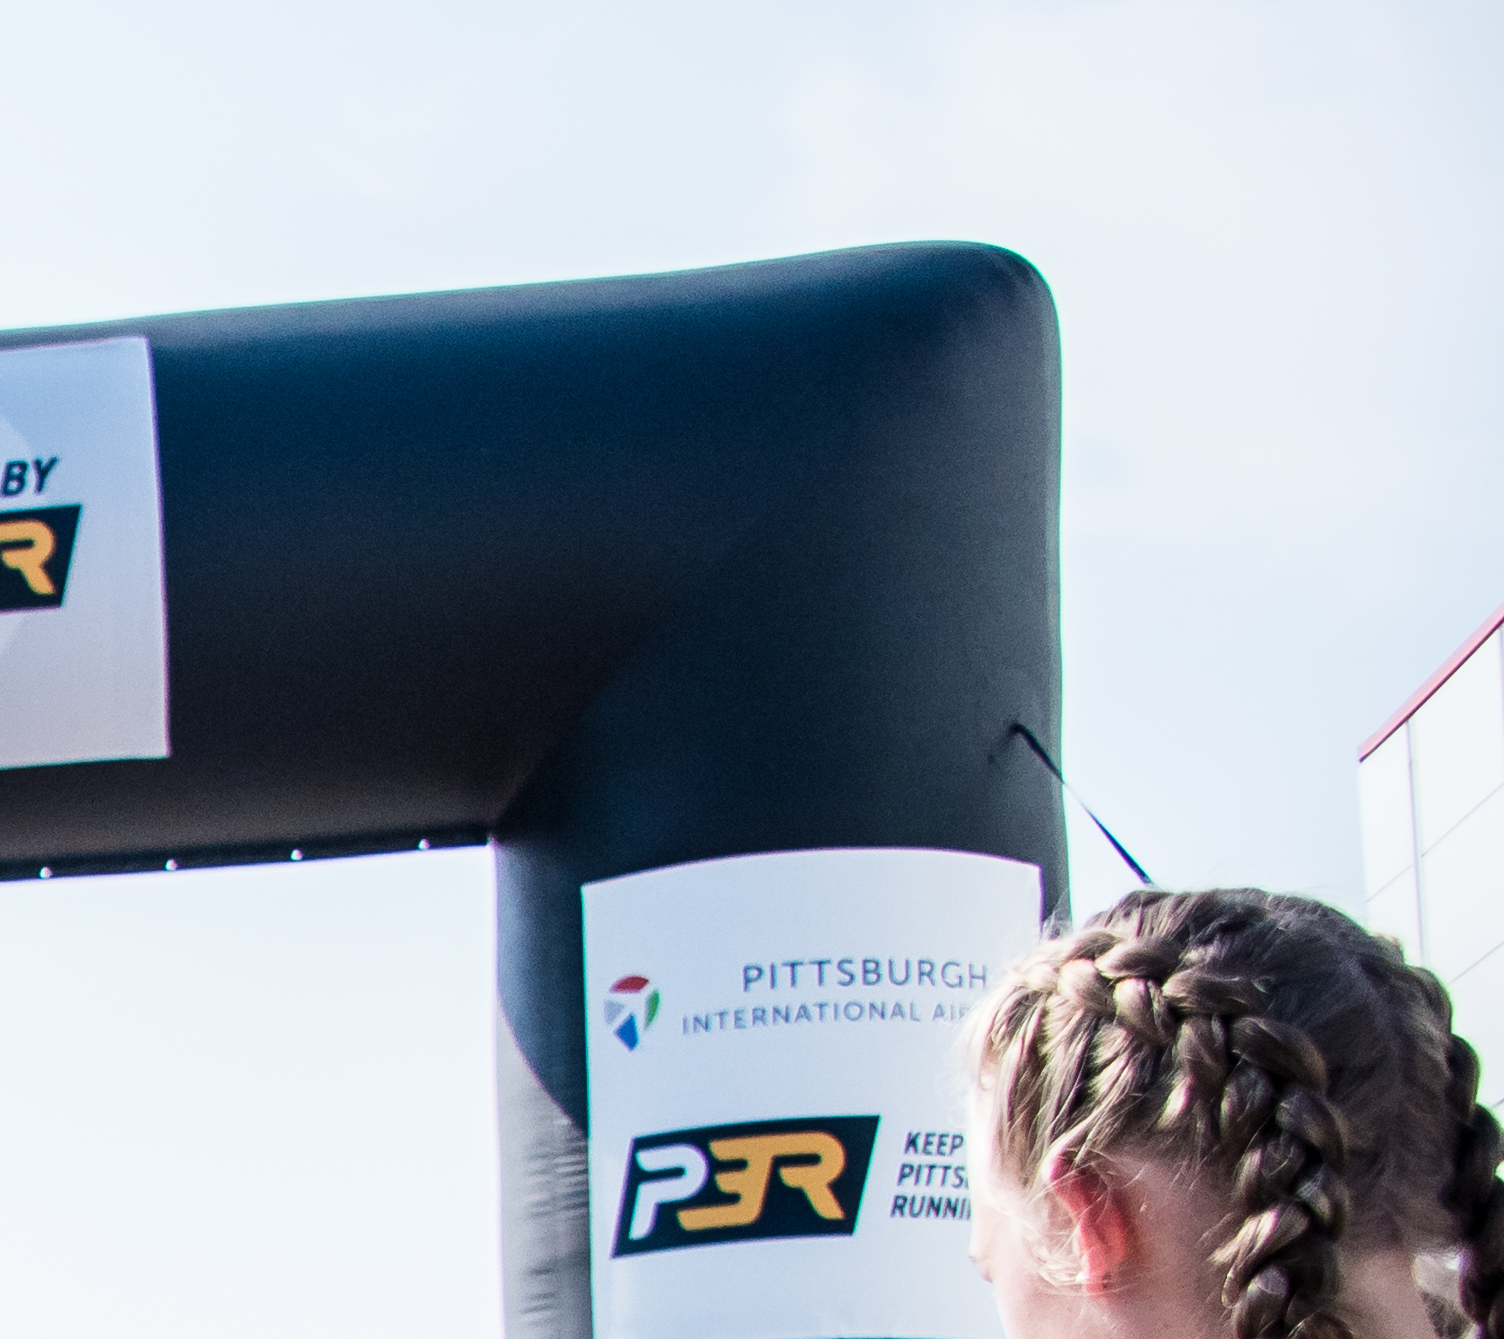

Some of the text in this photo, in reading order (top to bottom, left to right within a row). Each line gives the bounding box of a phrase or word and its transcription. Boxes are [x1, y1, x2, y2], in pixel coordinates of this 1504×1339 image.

[0, 457, 59, 498] BY
[742, 958, 987, 991] PITTSBURGH
[682, 1000, 921, 1035] INTERNATIONAL
[903, 1130, 965, 1155] KEEP
[897, 1161, 969, 1188] PITTS
